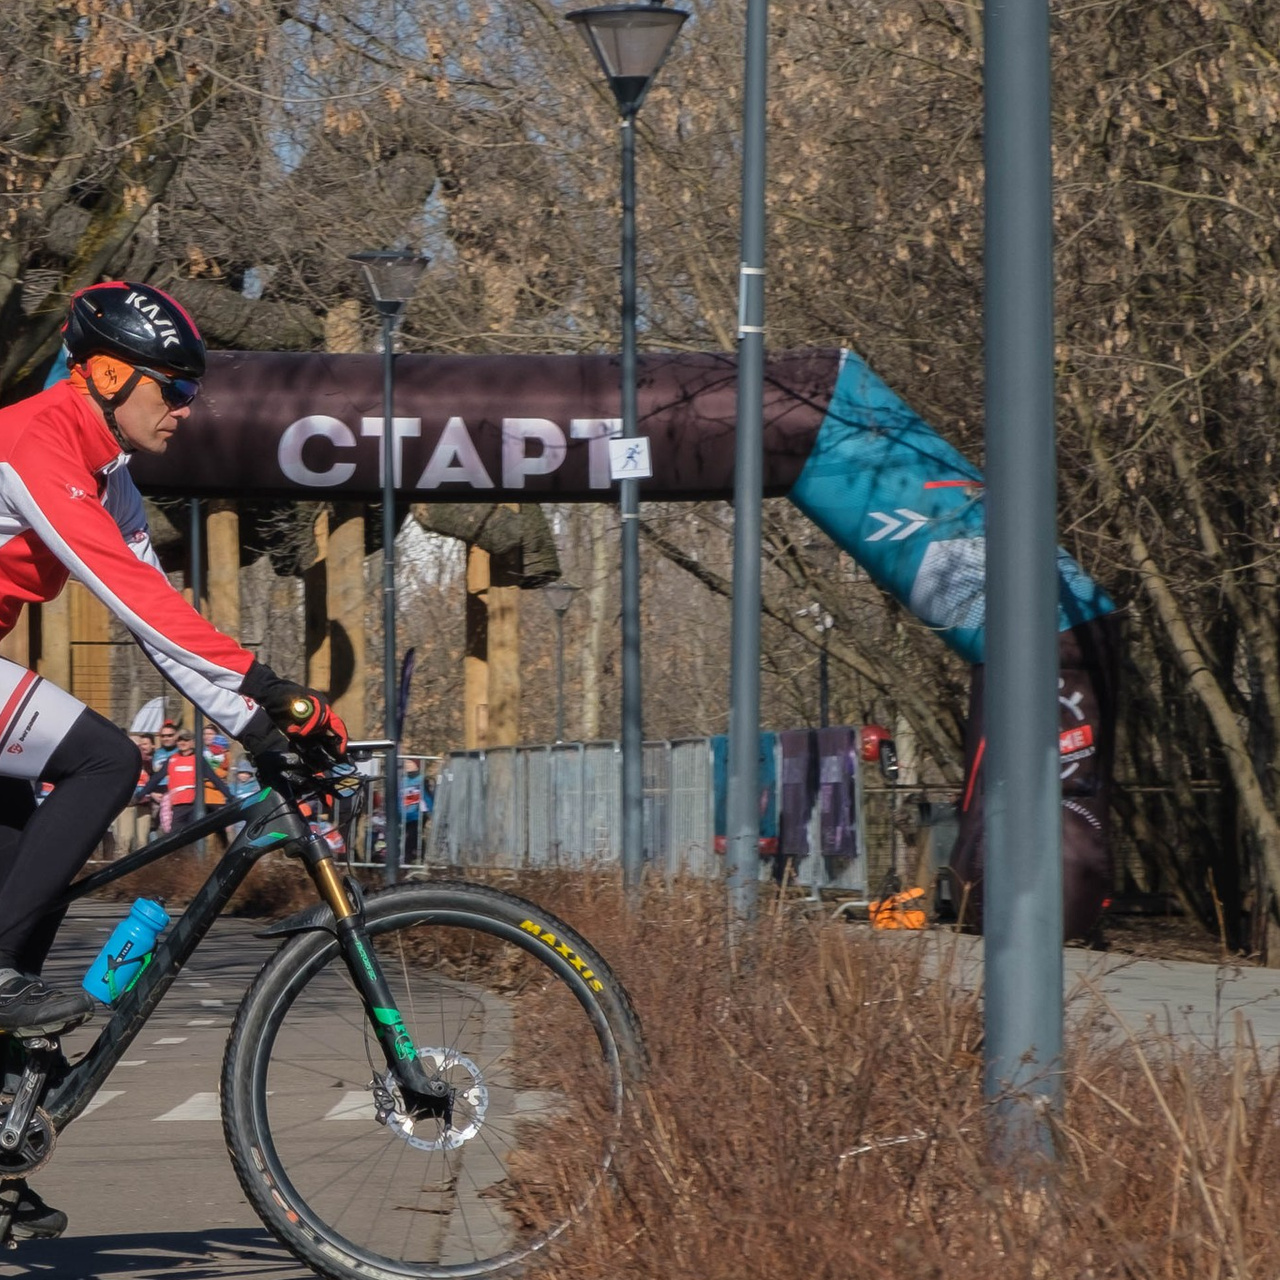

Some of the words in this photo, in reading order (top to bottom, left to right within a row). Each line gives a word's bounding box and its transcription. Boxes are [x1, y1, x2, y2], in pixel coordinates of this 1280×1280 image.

[125, 292, 180, 348] KASK
[277, 414, 623, 489] СТАРТ
[19, 711, 40, 742] bergamo
[520, 919, 604, 992] MAXXIS
